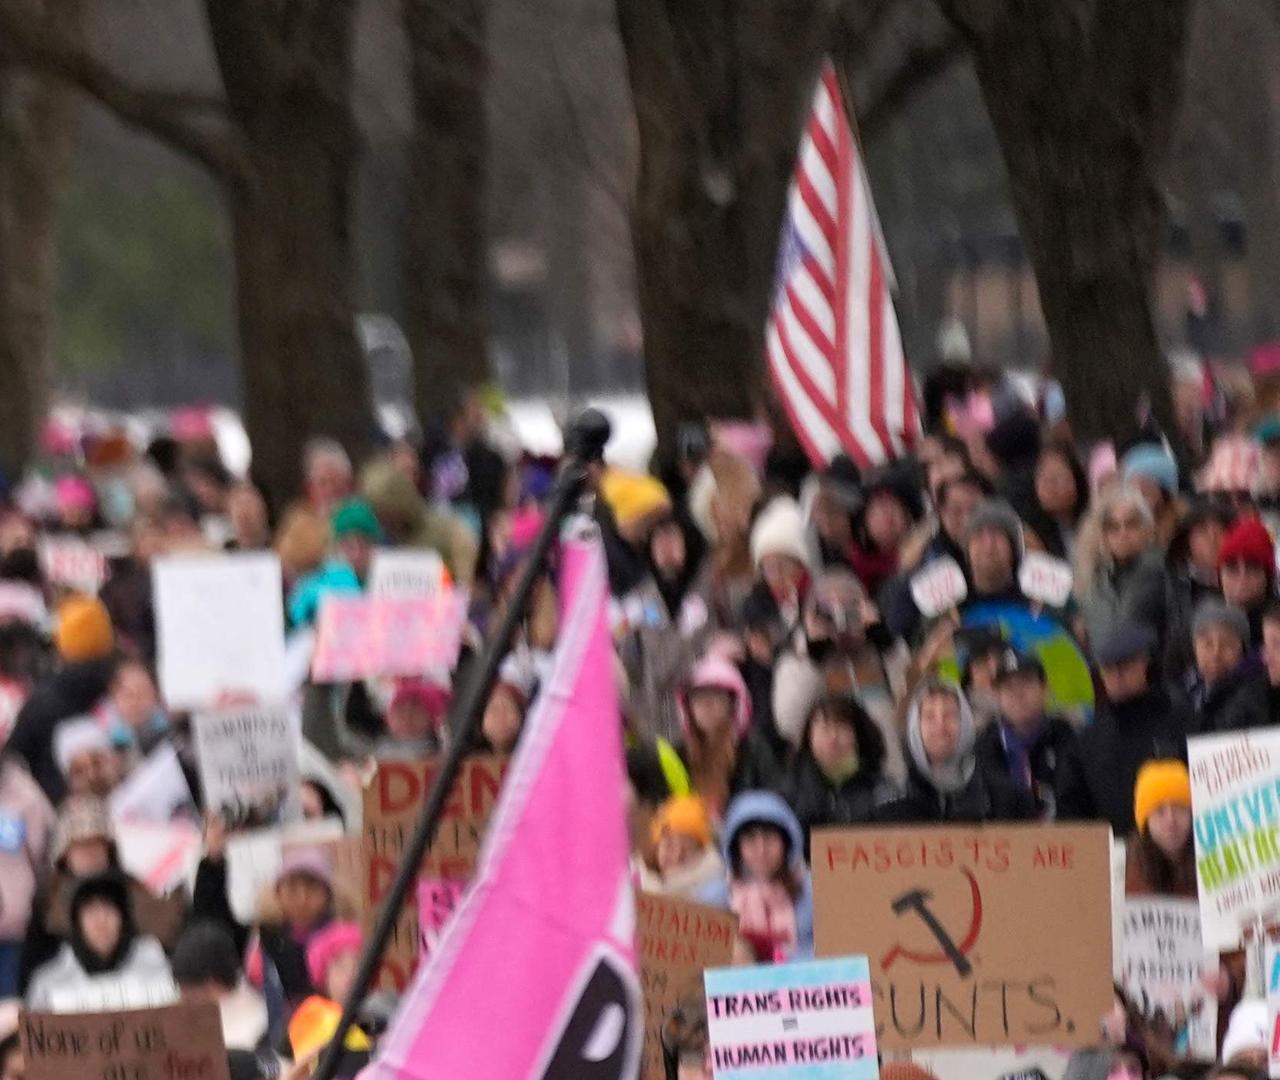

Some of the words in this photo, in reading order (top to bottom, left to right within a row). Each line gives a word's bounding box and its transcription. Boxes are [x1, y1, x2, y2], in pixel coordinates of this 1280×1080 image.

[827, 838, 1011, 873] FASCISTS
[1032, 844, 1076, 871] ARE
[711, 991, 782, 1019] TRANS
[787, 985, 863, 1012] RIGHTS
[97, 1018, 126, 1057] of
[715, 1041, 788, 1071] HUMAN
[793, 1034, 865, 1063] RIGHTS
